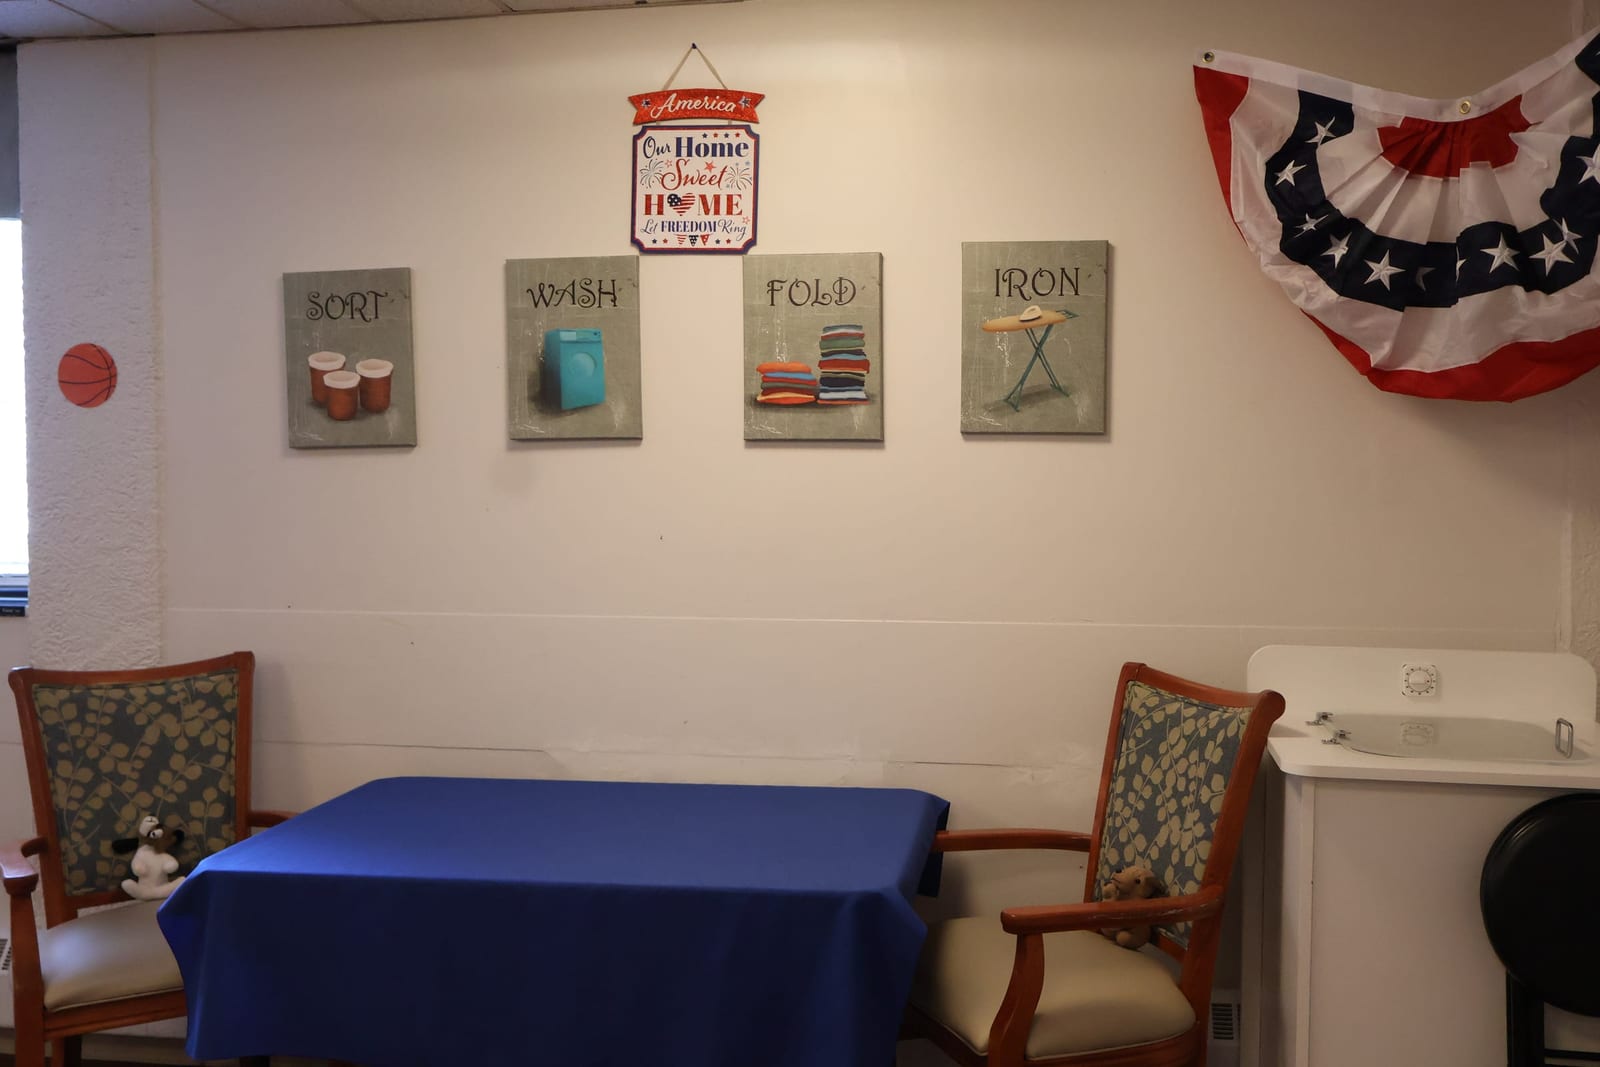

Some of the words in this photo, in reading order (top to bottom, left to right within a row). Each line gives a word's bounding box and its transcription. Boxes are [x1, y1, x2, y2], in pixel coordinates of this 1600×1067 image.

[650, 93, 736, 119] America
[643, 136, 672, 159] Our
[675, 136, 749, 158] Home
[661, 158, 728, 191] Sweet
[661, 220, 717, 233] FREEDOM
[717, 219, 747, 242] Ring
[526, 278, 618, 309] WASH
[766, 277, 857, 307] FOLD
[994, 267, 1080, 301] IRON
[305, 290, 389, 323] SORT
